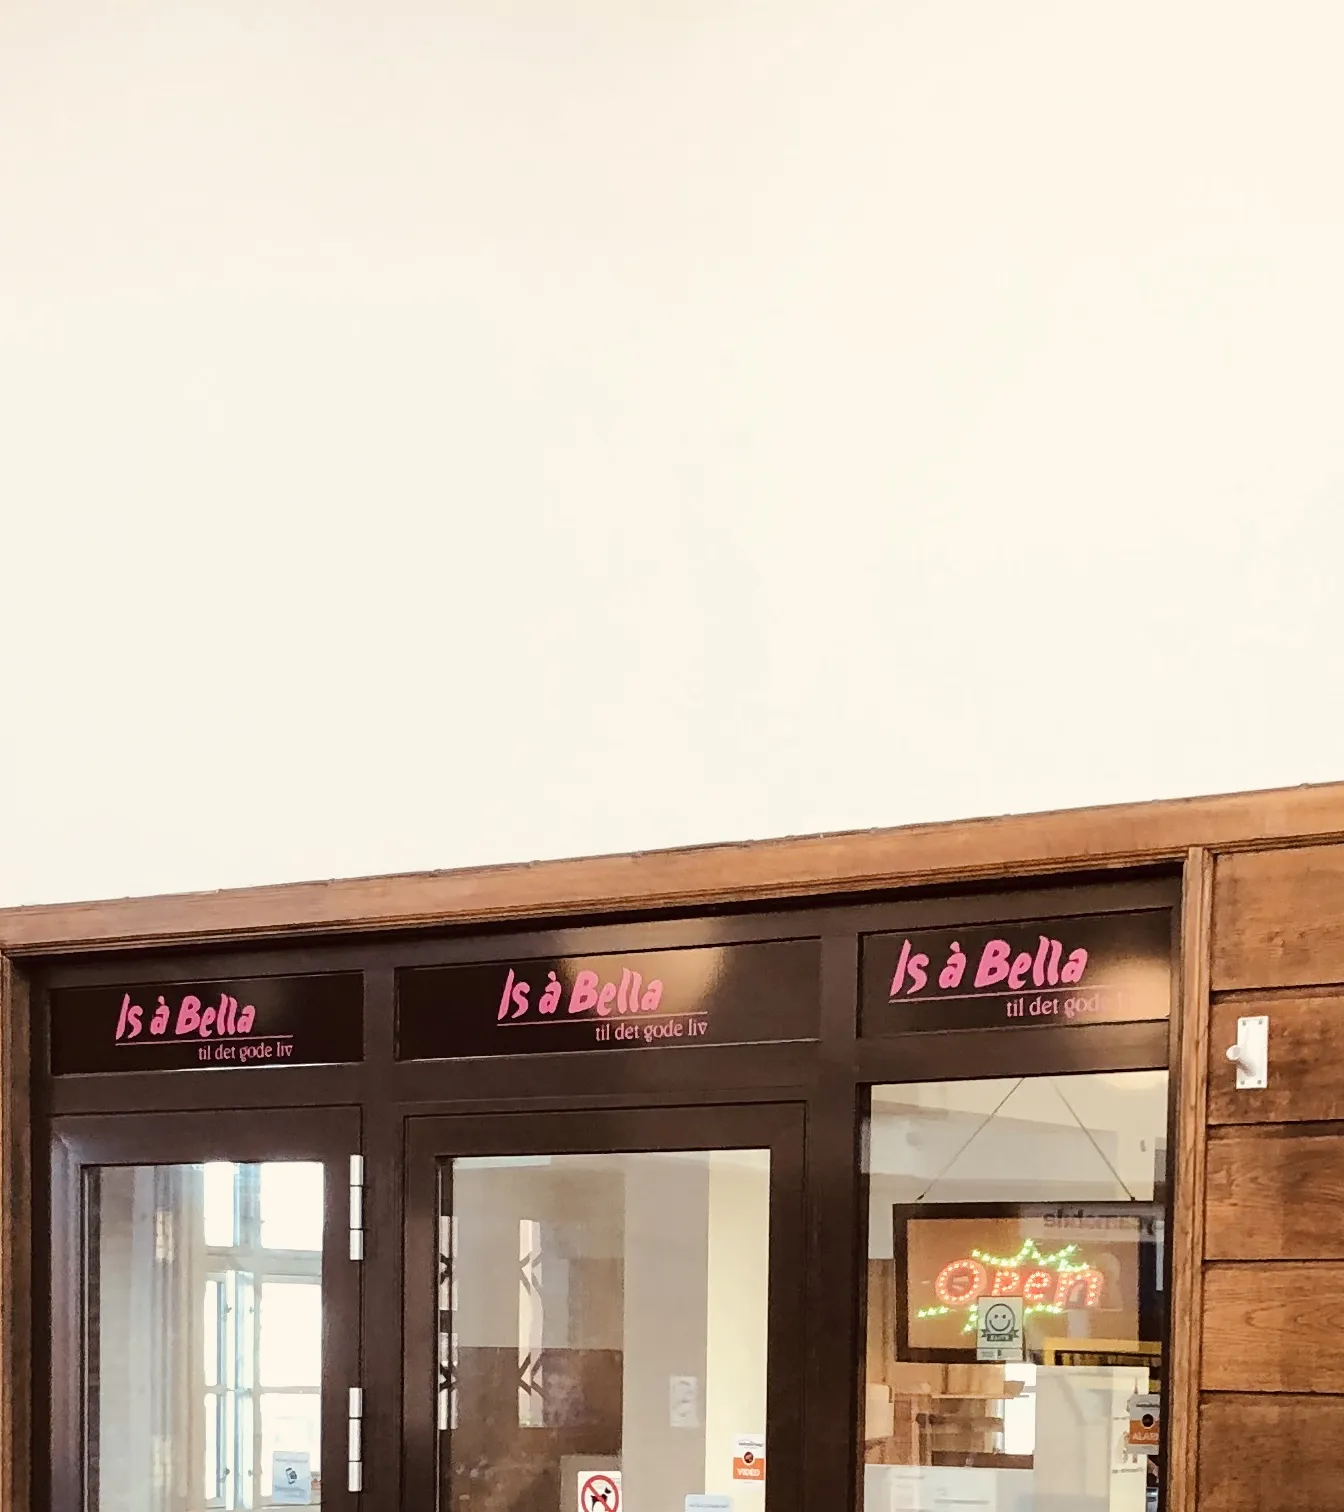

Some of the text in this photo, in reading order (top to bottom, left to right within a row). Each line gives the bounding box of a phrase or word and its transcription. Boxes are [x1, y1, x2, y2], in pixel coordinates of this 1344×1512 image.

[889, 935, 1088, 997] Is à Bella
[497, 967, 663, 1020] Is à Bella
[1006, 997, 1024, 1017] til
[1029, 996, 1058, 1016] det
[1064, 993, 1106, 1018] god
[115, 993, 256, 1040] Is à Bella
[595, 1018, 708, 1043] til det gode liv
[198, 1041, 293, 1063] til det gode liv
